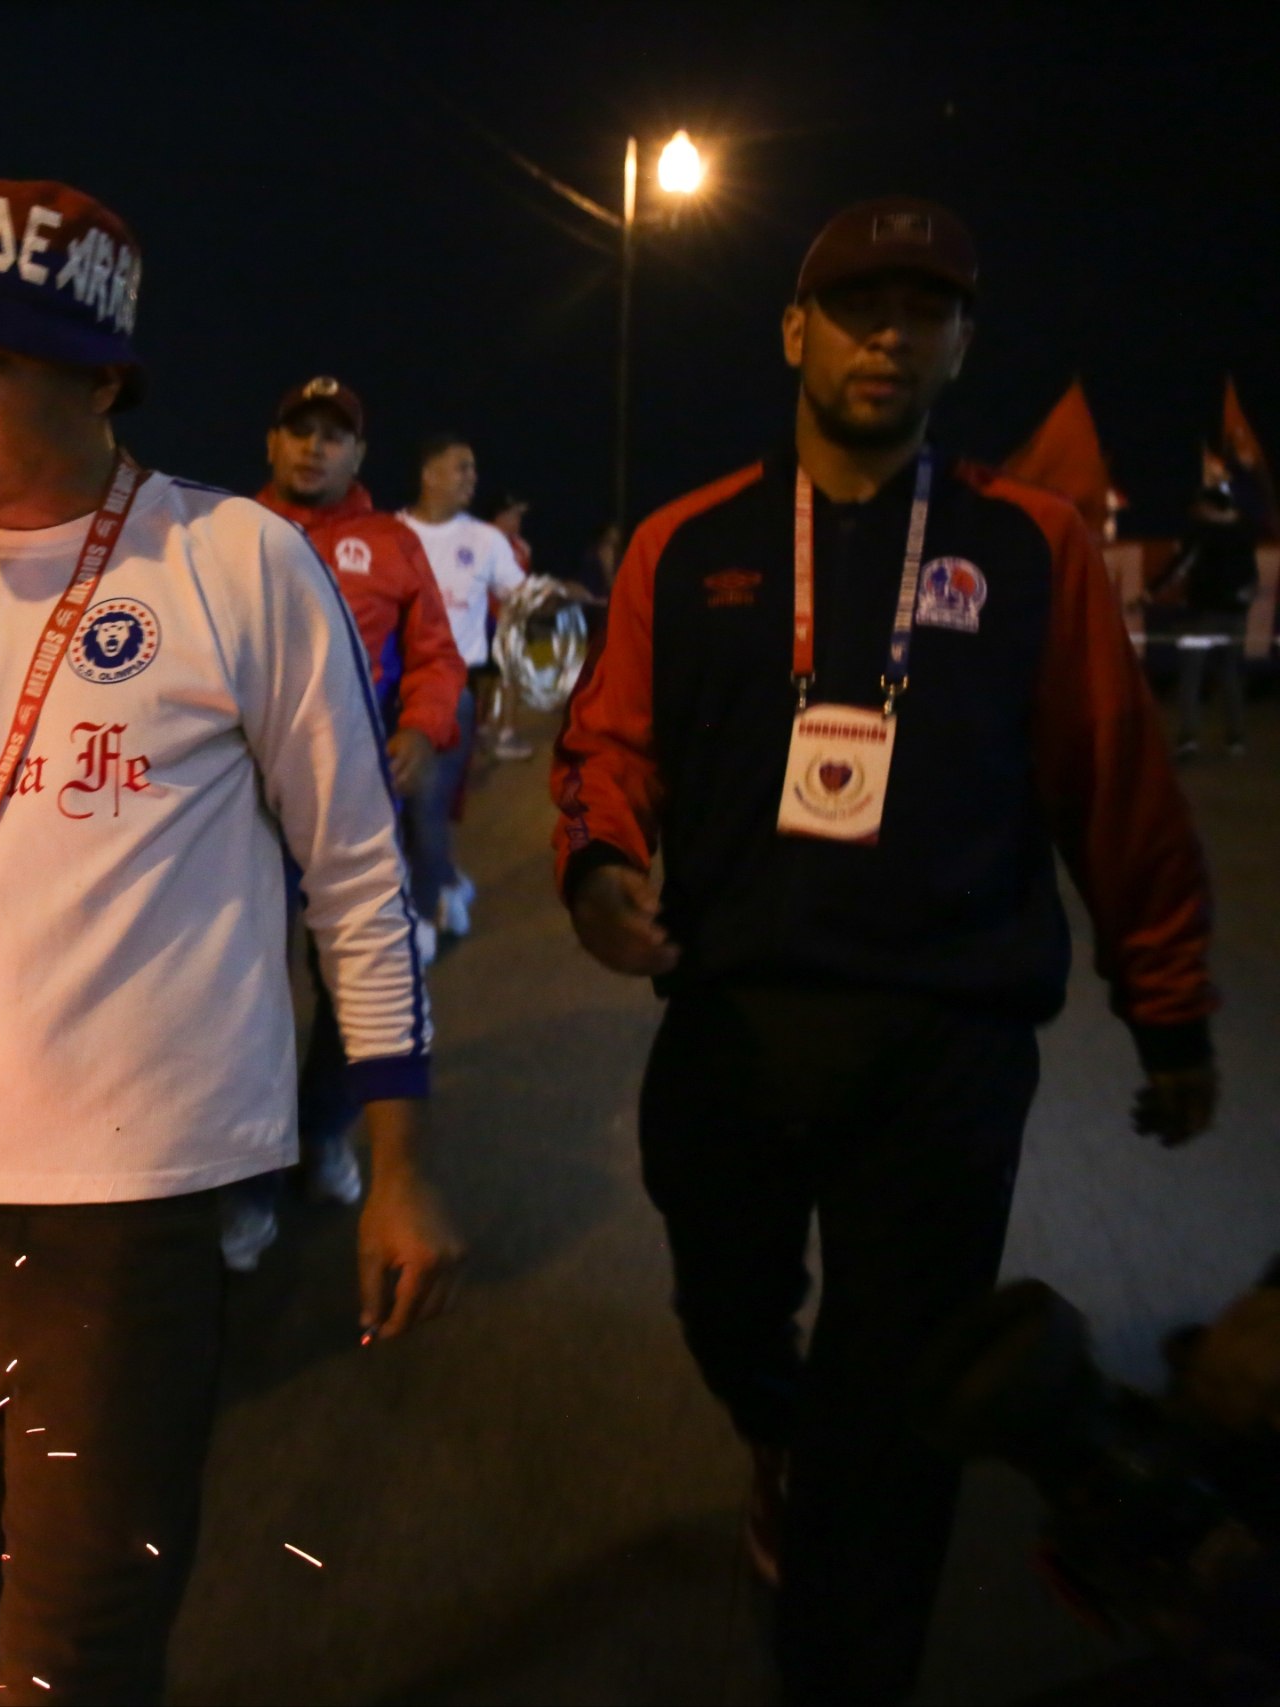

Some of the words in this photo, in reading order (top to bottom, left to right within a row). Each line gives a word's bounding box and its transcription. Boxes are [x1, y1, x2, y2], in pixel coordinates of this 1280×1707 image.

[65, 543, 108, 606] MEDIOS
[25, 629, 66, 698] MEDIOS
[57, 721, 151, 819] Fe
